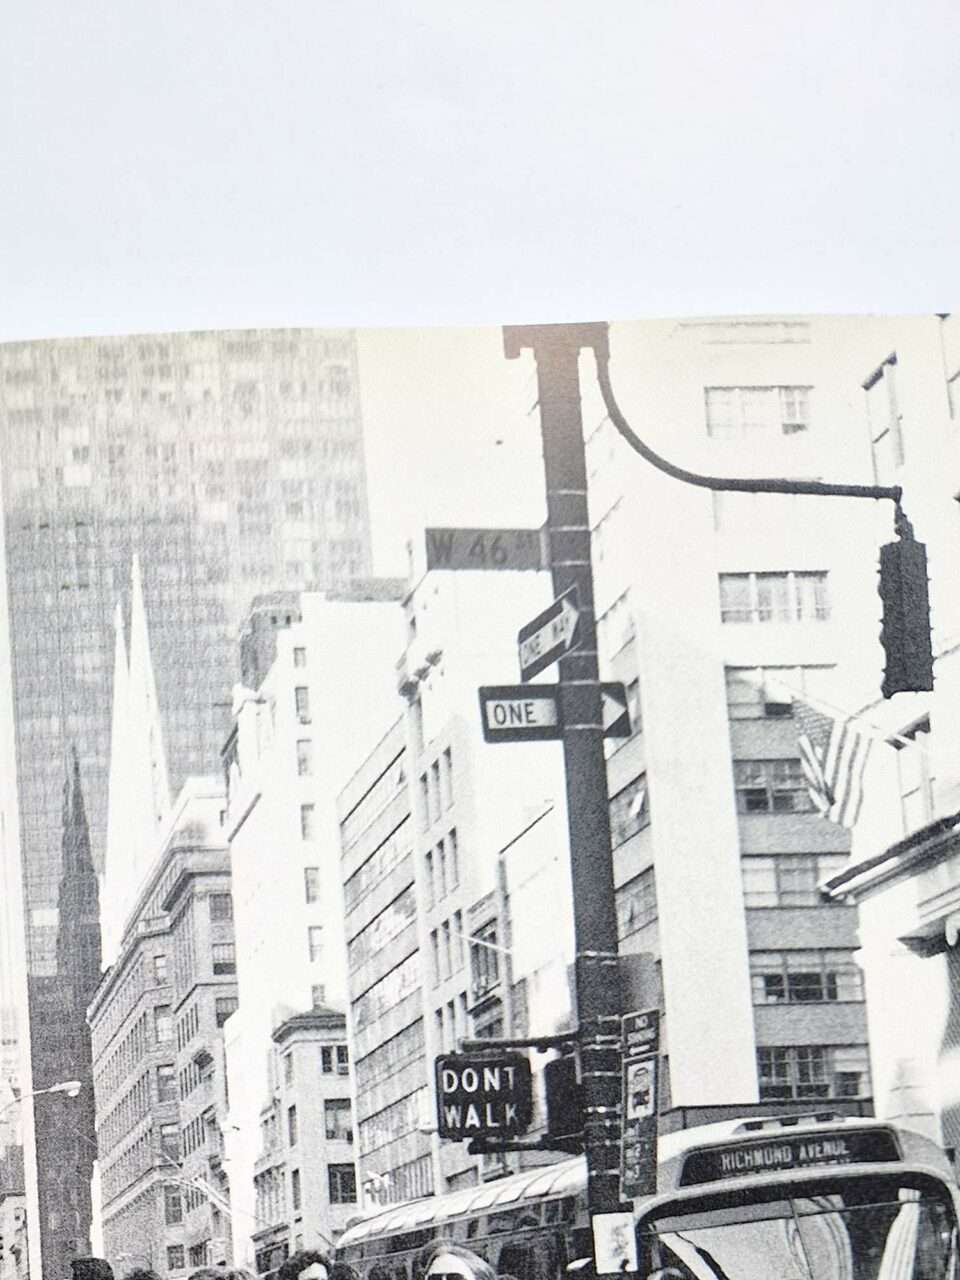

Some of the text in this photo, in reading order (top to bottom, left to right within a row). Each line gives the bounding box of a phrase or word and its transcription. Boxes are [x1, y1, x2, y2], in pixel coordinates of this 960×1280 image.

[431, 533, 454, 563] W
[468, 533, 508, 564] 46
[493, 702, 537, 726] ONE
[442, 1066, 516, 1094] DONT
[444, 1102, 518, 1129] WALK
[721, 1139, 851, 1171] RICHMOND AVENUE
